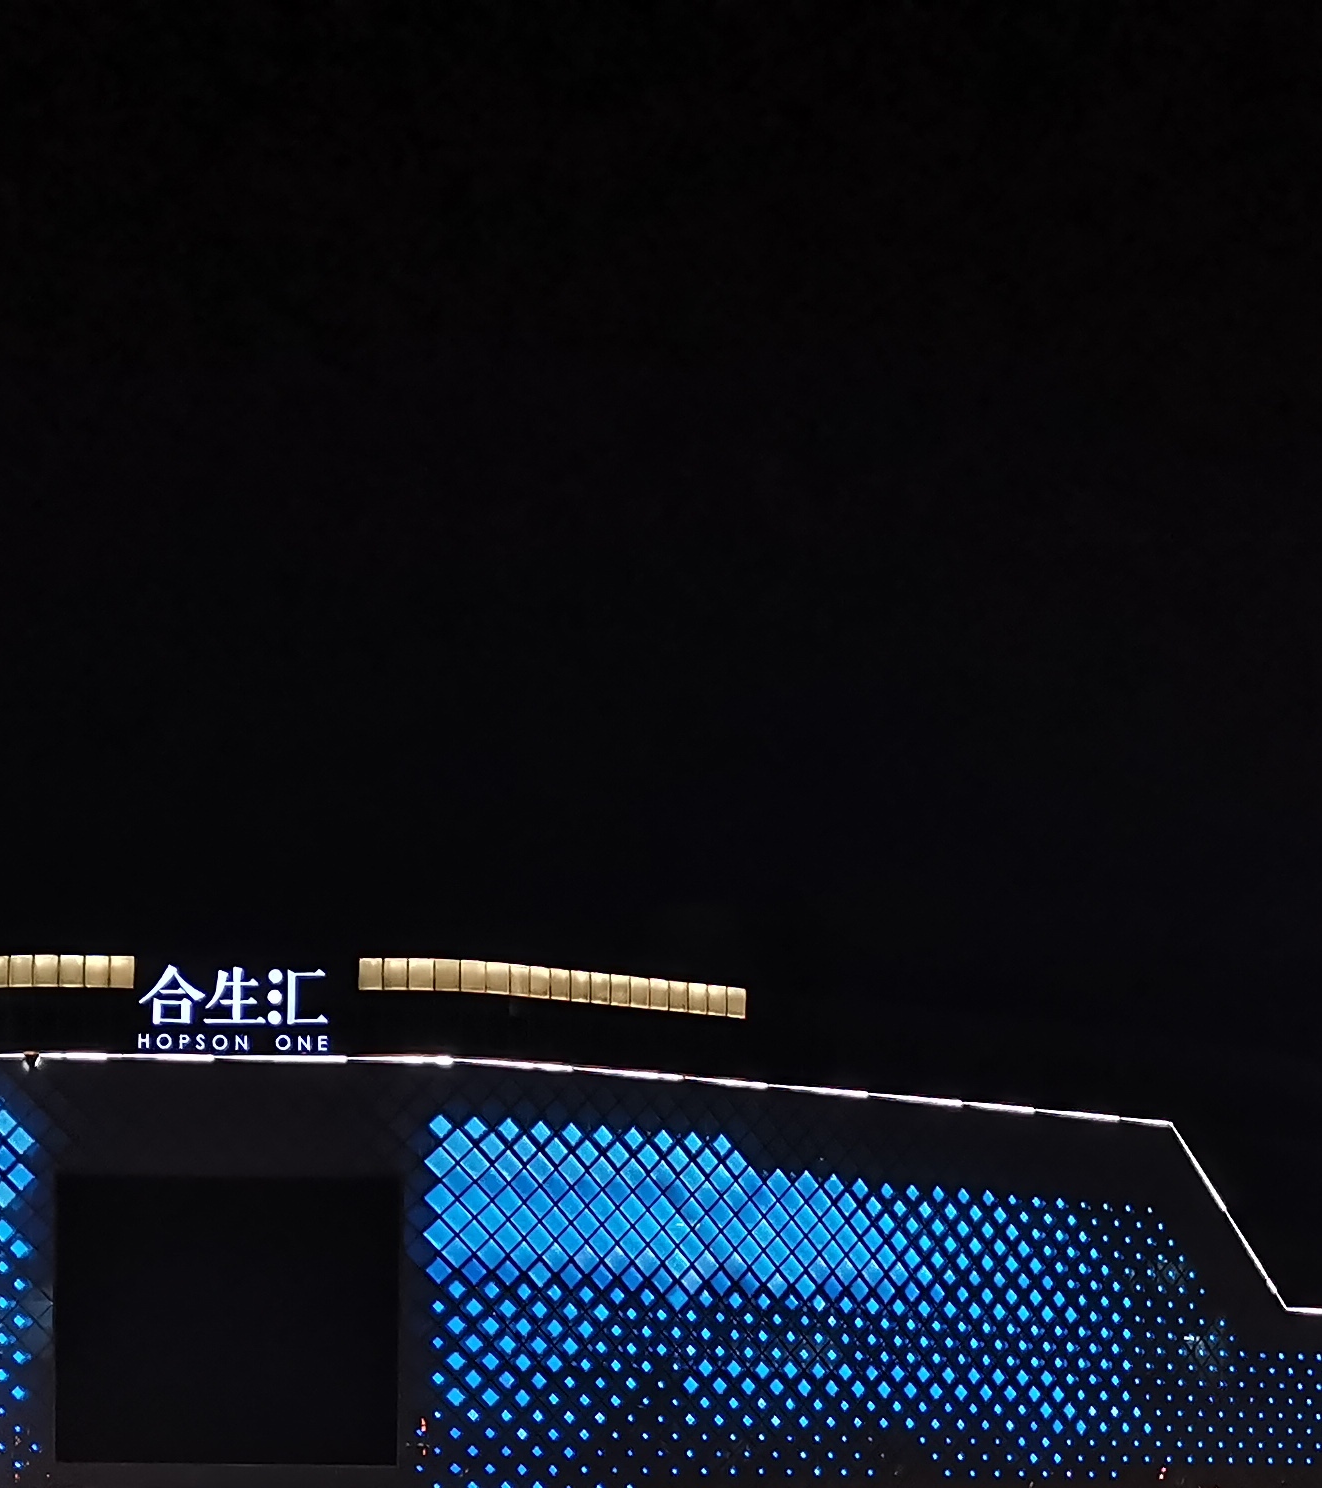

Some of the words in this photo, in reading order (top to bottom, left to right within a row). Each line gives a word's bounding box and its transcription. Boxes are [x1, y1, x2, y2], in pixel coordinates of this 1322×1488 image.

[138, 964, 329, 1026] 合生汇
[137, 1033, 250, 1052] HOPSON
[275, 1034, 329, 1052] ONE
